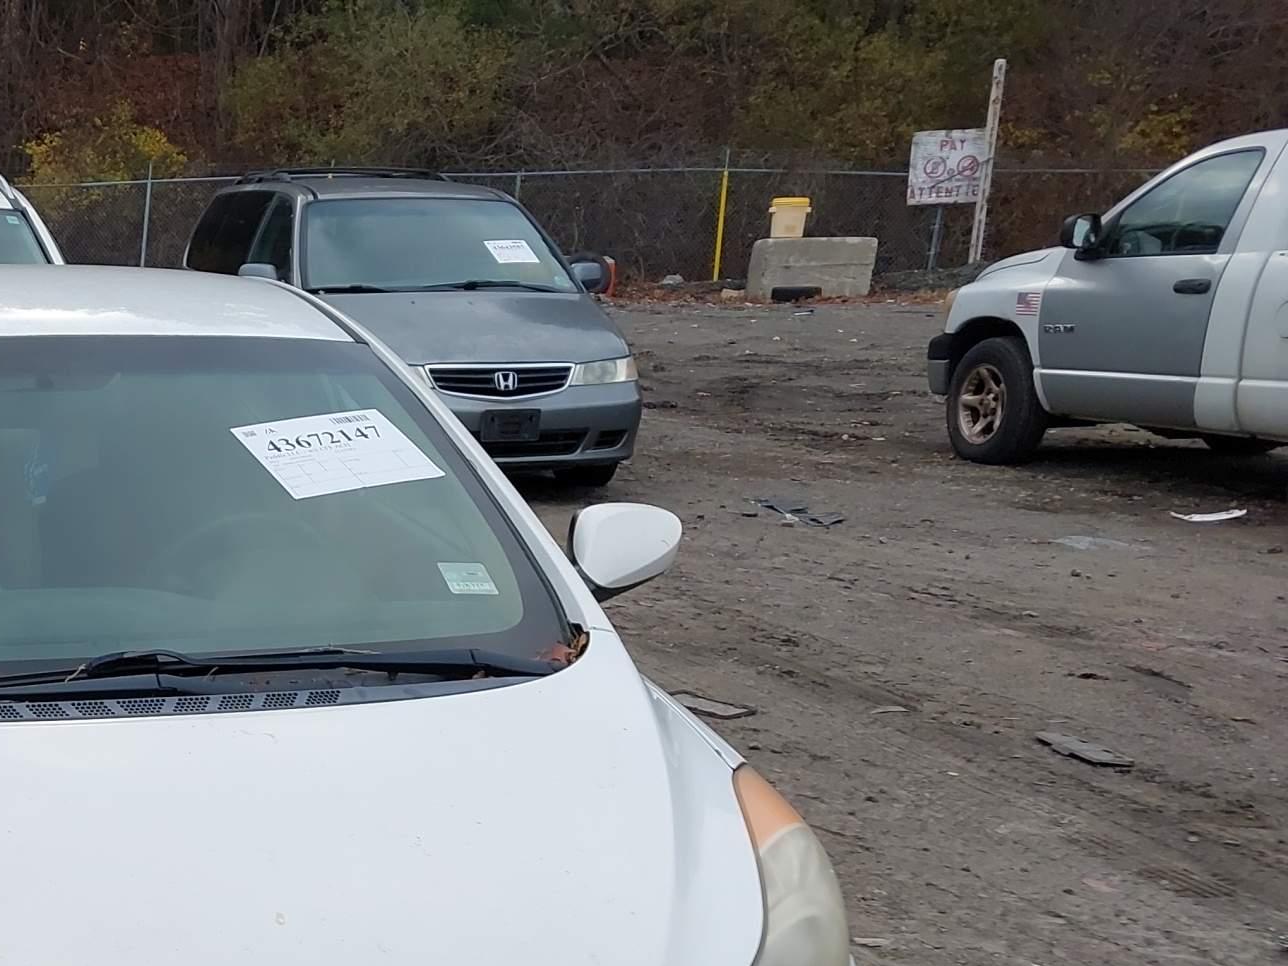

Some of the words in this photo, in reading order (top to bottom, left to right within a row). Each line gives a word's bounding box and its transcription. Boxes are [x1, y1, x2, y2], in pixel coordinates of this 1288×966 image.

[939, 139, 967, 152] PAY
[908, 184, 980, 200] ATTENTIO
[1043, 323, 1076, 334] RAM
[267, 425, 381, 453] 43672147
